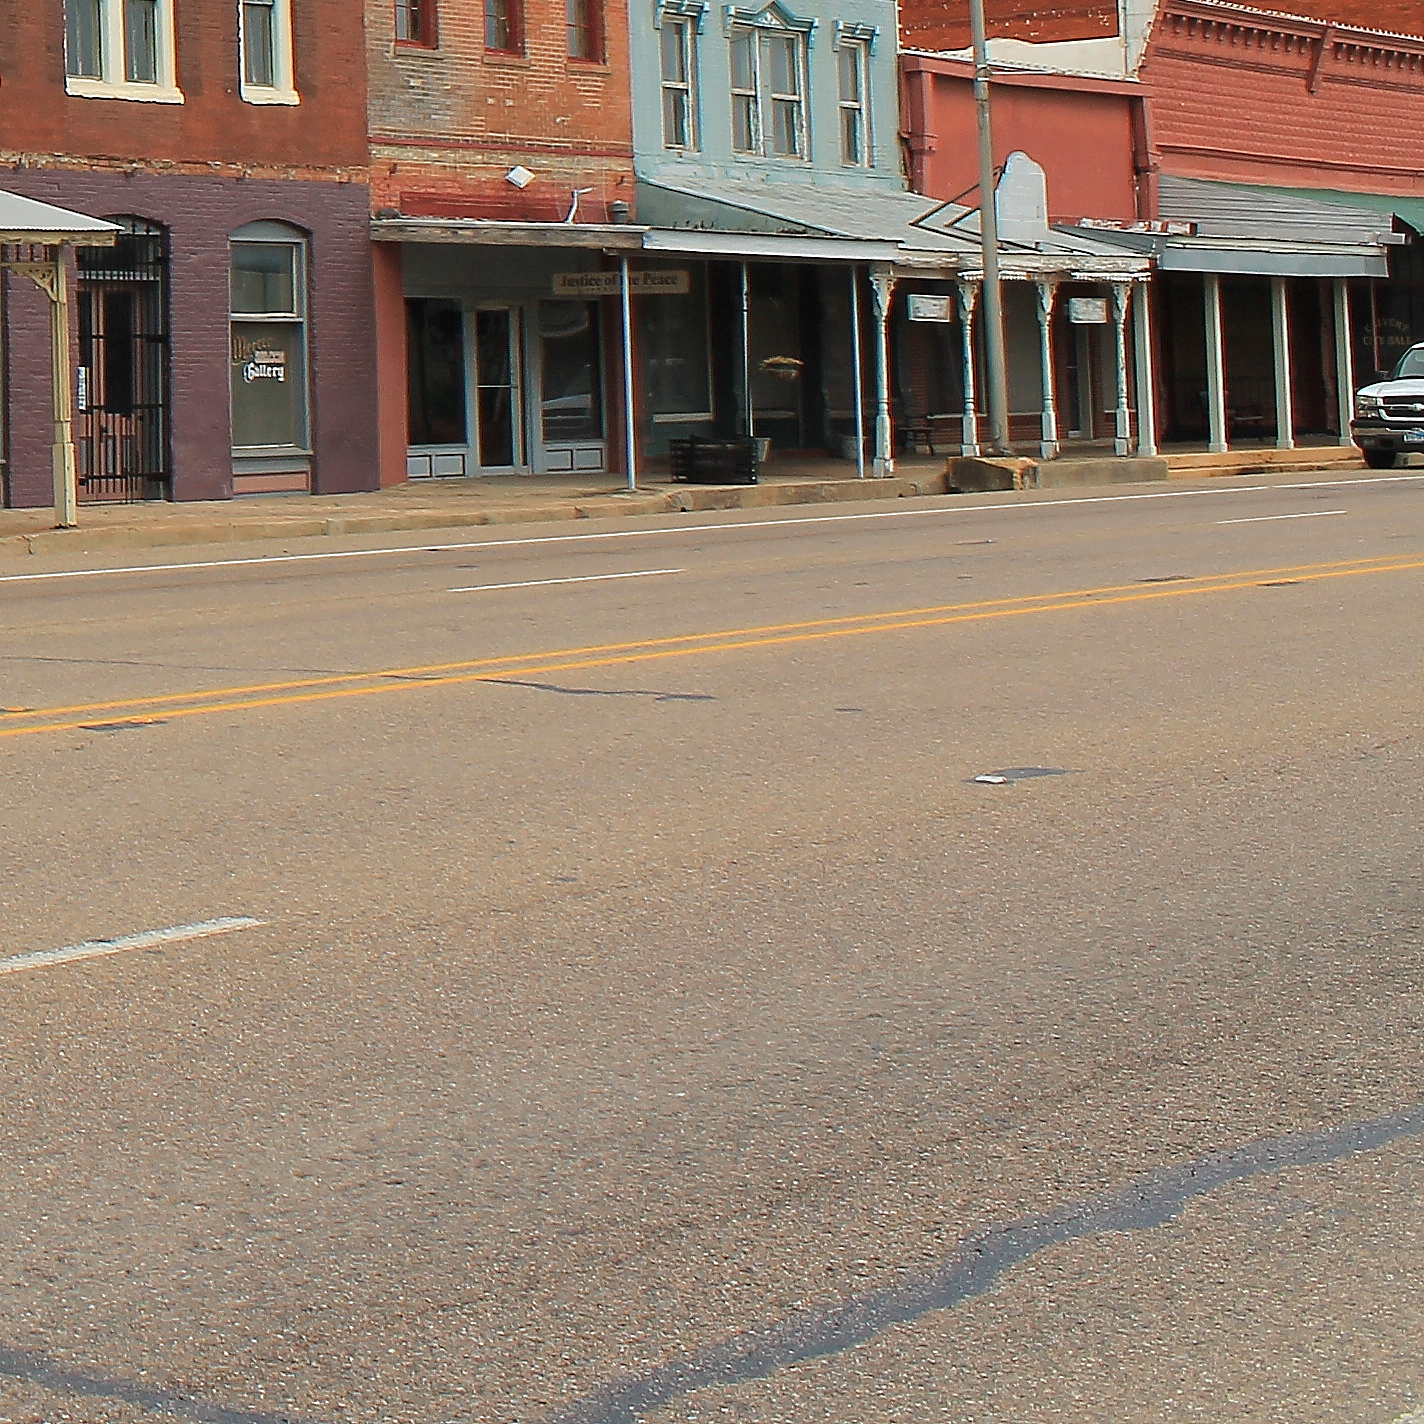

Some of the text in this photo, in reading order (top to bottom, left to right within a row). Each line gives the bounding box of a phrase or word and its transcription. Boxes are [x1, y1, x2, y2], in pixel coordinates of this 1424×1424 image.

[558, 274, 602, 287] Justice
[641, 273, 678, 287] Peace
[243, 362, 285, 384] Gallery
